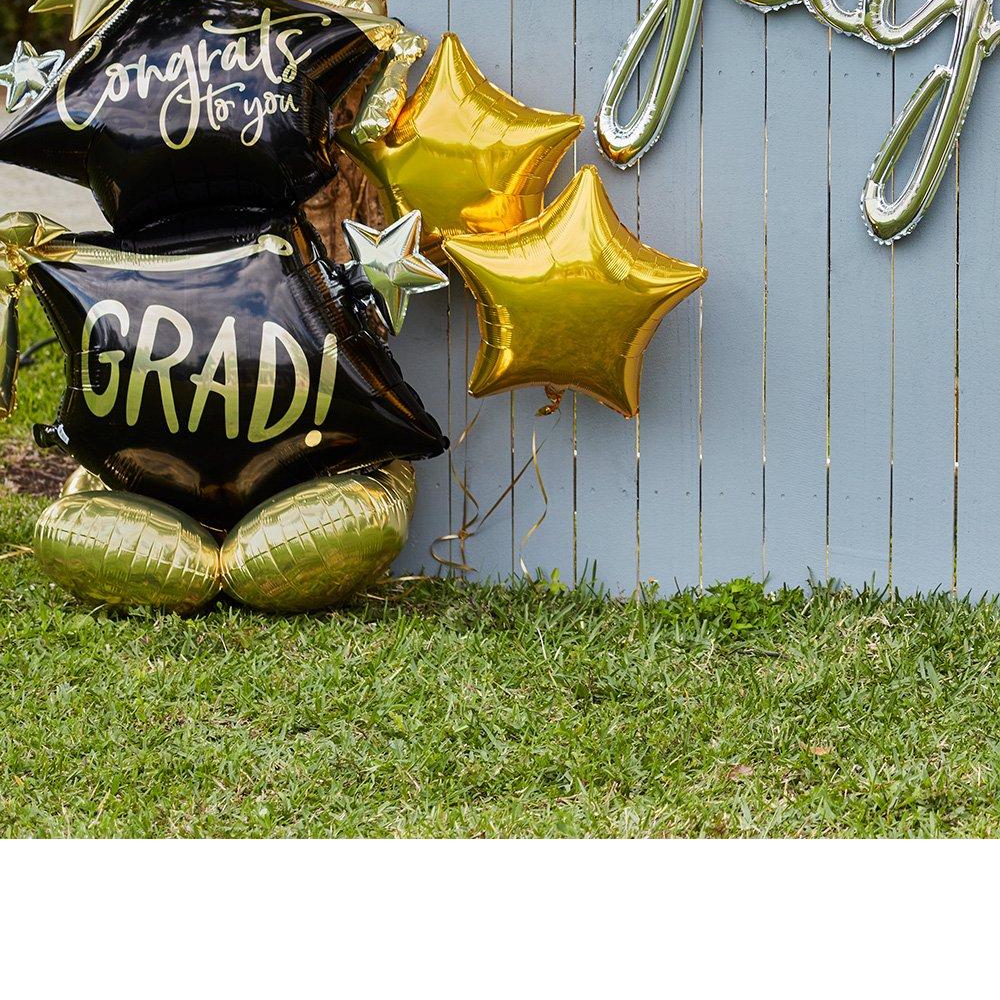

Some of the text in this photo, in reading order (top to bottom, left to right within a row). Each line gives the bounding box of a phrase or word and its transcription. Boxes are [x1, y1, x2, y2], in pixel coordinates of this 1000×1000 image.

[56, 7, 332, 150] Congrats
[178, 82, 300, 147] to you
[80, 299, 339, 448] GRAD!
